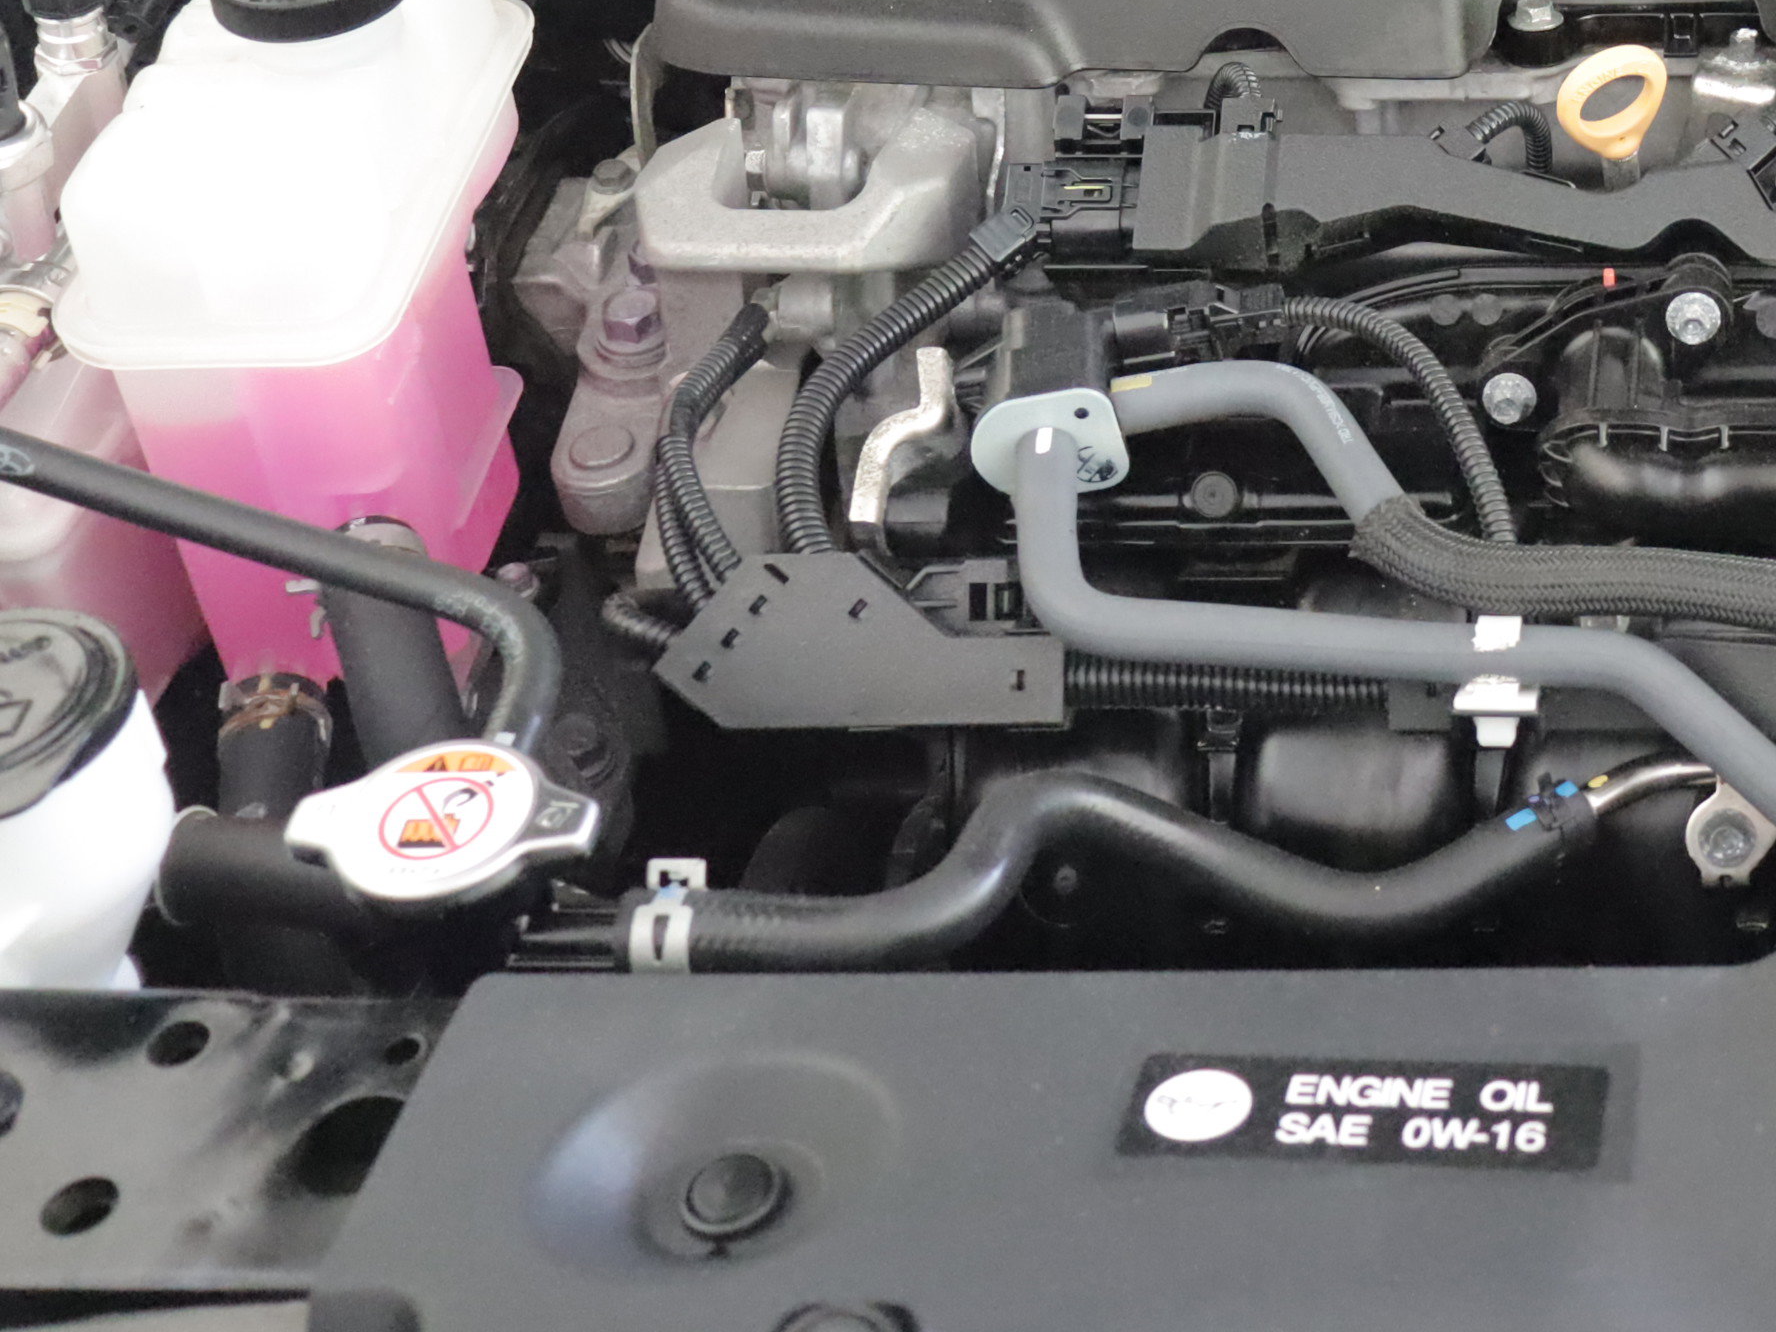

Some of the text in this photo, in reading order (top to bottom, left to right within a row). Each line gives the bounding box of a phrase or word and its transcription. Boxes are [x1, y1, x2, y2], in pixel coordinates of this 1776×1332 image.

[1284, 1073, 1555, 1114] ENGINE OIL
[1274, 1111, 1548, 1154] SAE 0W-16
